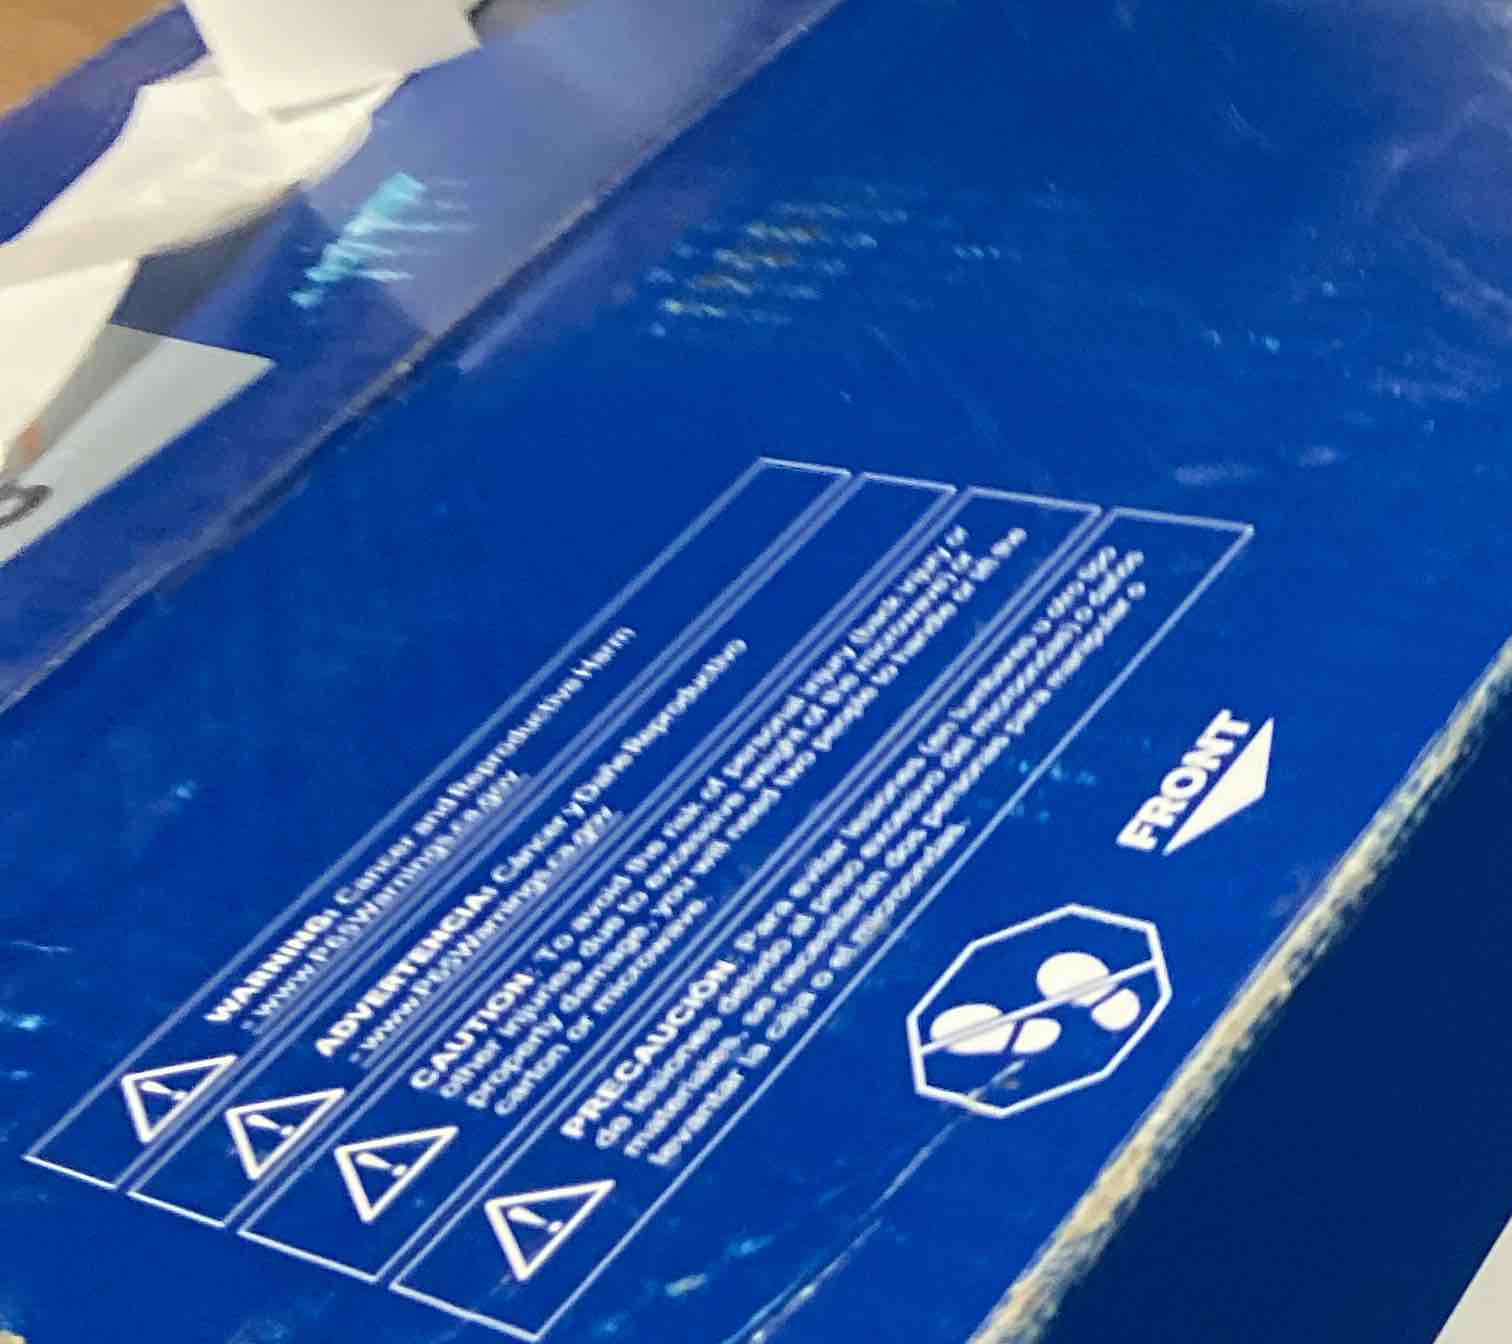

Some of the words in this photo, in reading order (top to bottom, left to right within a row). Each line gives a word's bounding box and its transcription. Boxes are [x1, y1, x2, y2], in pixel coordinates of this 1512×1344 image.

[206, 909, 339, 1021] WARNING:
[334, 836, 415, 904] Cancer
[413, 796, 458, 835] and
[447, 678, 581, 797] Reproductive
[572, 627, 635, 677] Harm
[316, 886, 496, 1055] ADVERTENCIA:
[622, 639, 746, 752] Reproductivo
[1117, 708, 1251, 852] FRONT
[498, 960, 581, 1036] injuries
[578, 915, 624, 957] due
[616, 890, 648, 913] to
[533, 933, 574, 960] To
[570, 874, 631, 932] avoid
[624, 839, 666, 872] the
[733, 899, 794, 952] Para
[466, 1013, 562, 1108] property
[650, 876, 695, 917] you
[690, 840, 729, 874] will
[494, 1043, 569, 1114] carton
[565, 1014, 593, 1040] or
[648, 1069, 743, 1165] levantar
